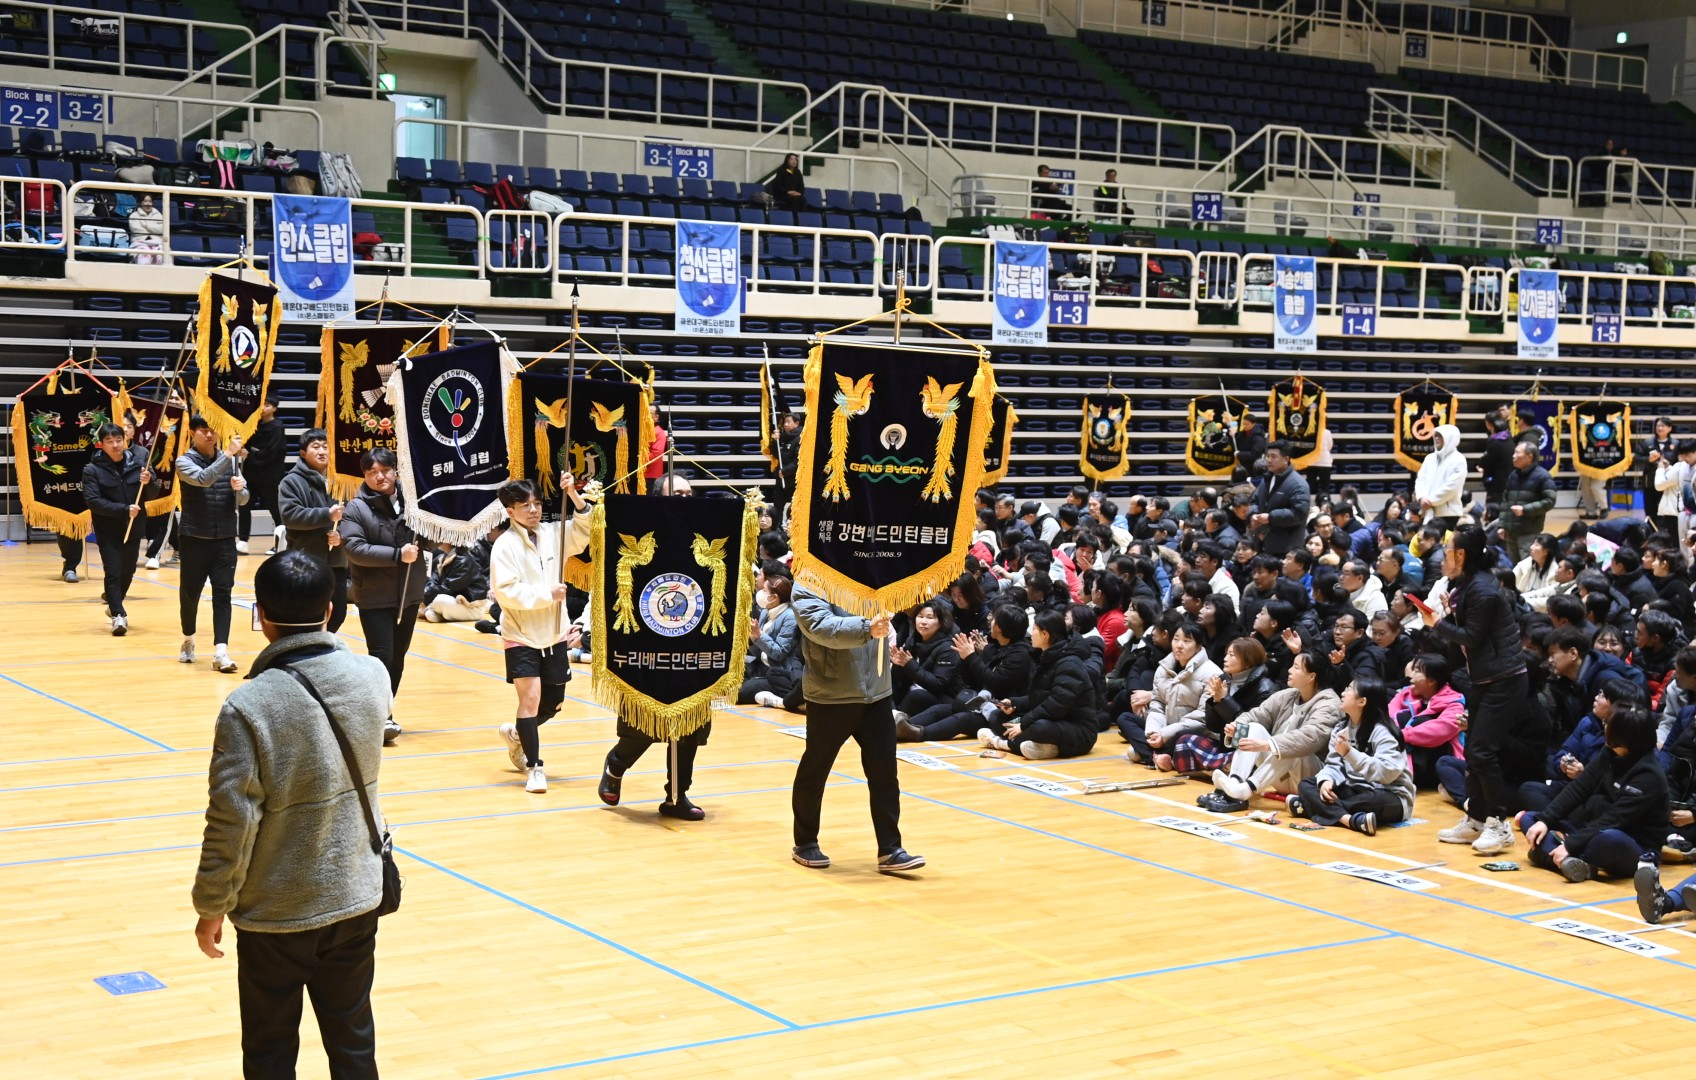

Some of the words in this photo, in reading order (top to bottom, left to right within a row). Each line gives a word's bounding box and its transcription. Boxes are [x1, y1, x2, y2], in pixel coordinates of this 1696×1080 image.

[5, 90, 30, 101] Block
[9, 104, 50, 127] 2-2
[69, 101, 103, 121] 3-2
[675, 147, 693, 156] Block
[679, 159, 708, 178] 2-3
[1197, 203, 1219, 220] 2-4
[278, 220, 349, 263] 한스클럽
[1540, 228, 1559, 244] 2-5
[680, 243, 737, 285] 청산클럽
[1052, 292, 1070, 302] Block
[1055, 305, 1083, 324] 1-3
[1347, 317, 1371, 335] 1-4
[1596, 325, 1618, 343] 1-5
[422, 382, 438, 419] DONGHAE
[441, 370, 479, 386] BADMINTON
[432, 460, 454, 477] 동해
[470, 450, 490, 467] 클럽
[838, 522, 949, 545] 강변배드민턴클럽
[853, 550, 876, 559] SINCE
[875, 550, 902, 559] 2008.9
[645, 616, 685, 635] BADMINTON
[684, 616, 699, 630] CLUB
[613, 650, 726, 670] 누리배드민턴클럽
